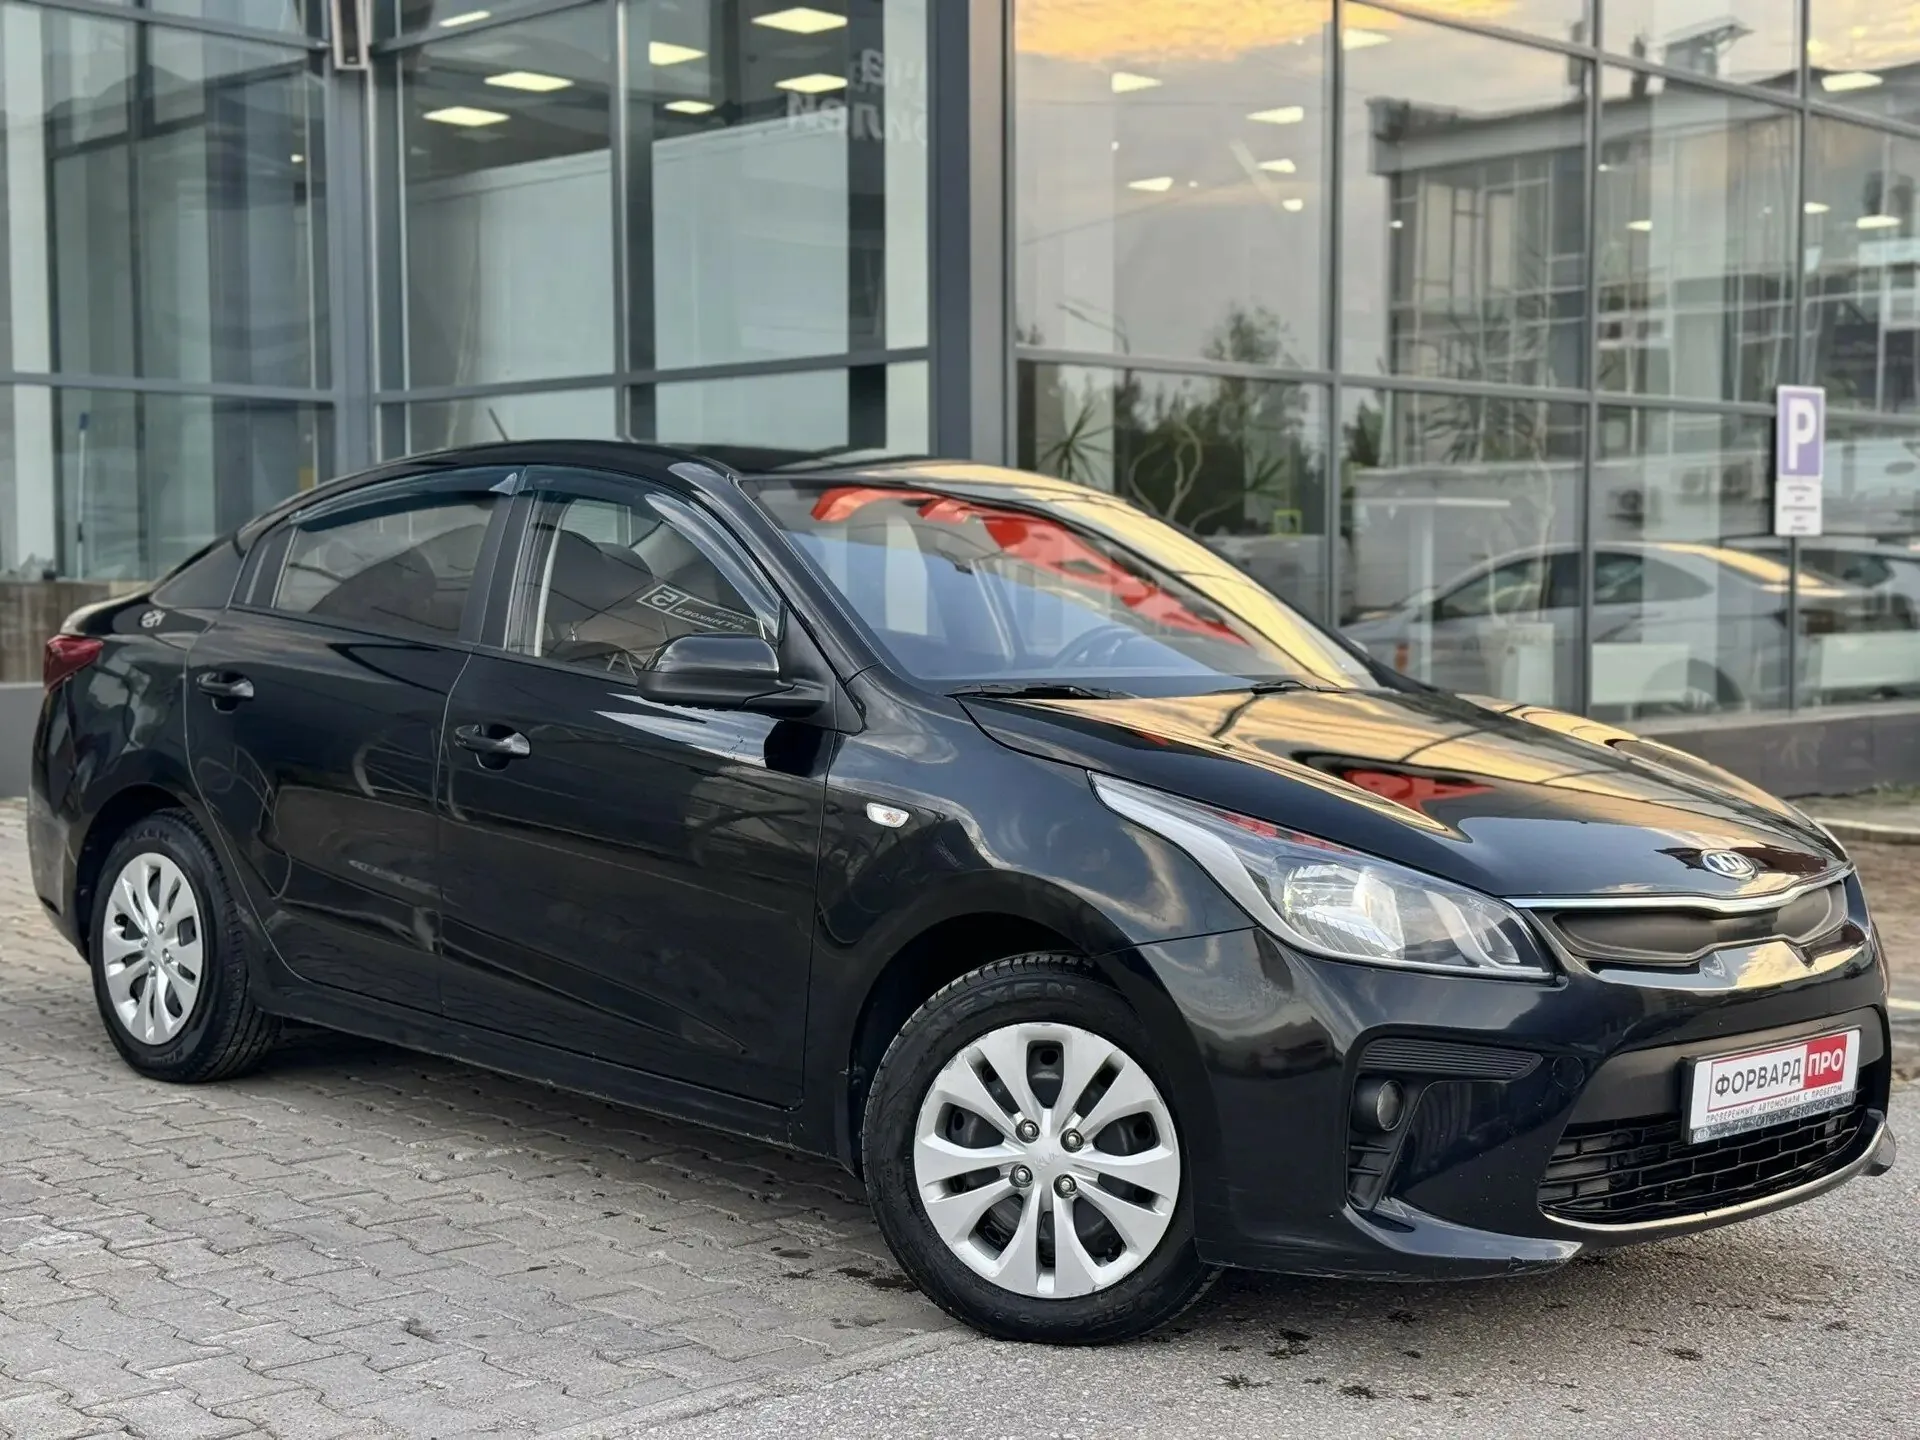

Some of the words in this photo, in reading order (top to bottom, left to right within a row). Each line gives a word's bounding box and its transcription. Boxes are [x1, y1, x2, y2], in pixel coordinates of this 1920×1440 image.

[1788, 397, 1817, 470] P
[1714, 1057, 1801, 1097] ФОРВАРД
[1807, 1048, 1844, 1077] ПРО
[1758, 1095, 1801, 1110] АВТОМОБИЛИ
[1811, 1085, 1843, 1099] ПРОБЕГОМ
